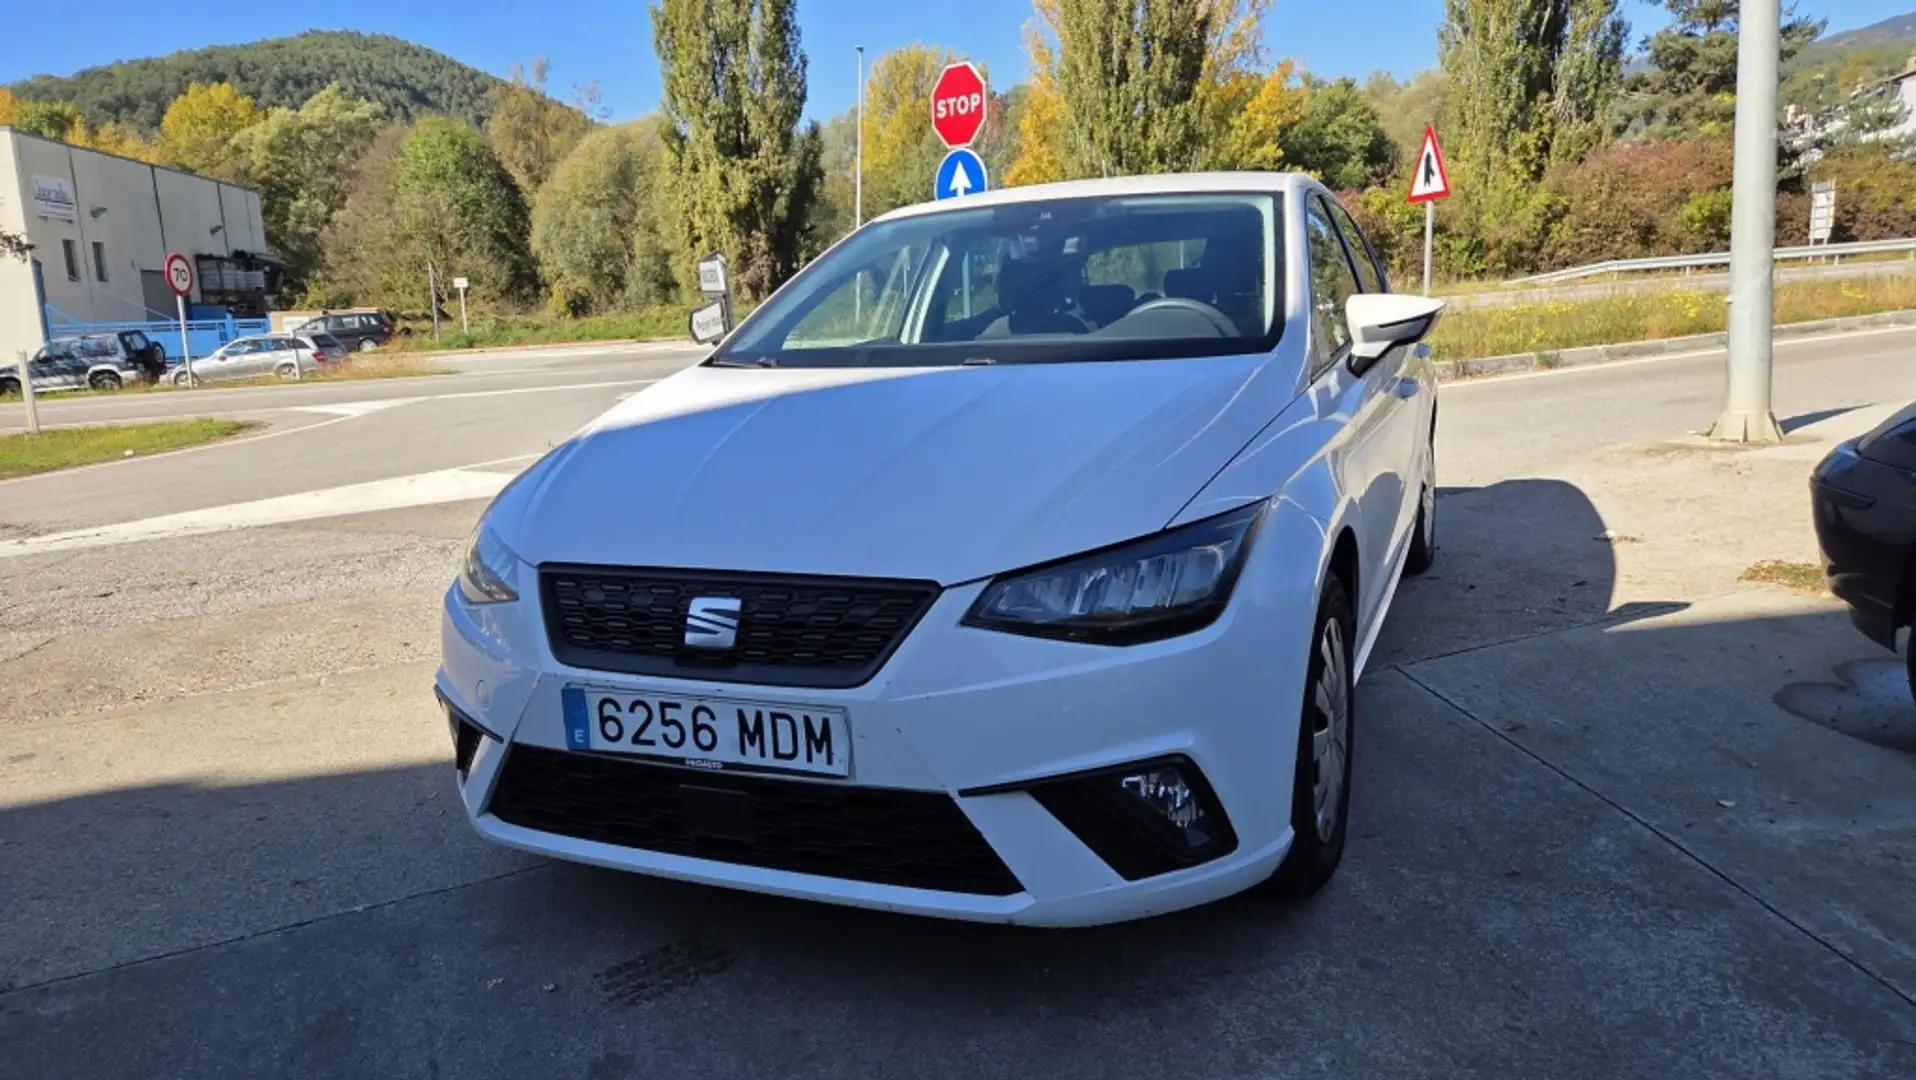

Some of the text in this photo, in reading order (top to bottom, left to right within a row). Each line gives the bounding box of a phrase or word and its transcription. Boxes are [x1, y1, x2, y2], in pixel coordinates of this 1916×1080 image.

[936, 92, 981, 119] STOP
[172, 267, 188, 282] 70
[574, 729, 585, 743] E
[598, 697, 834, 766] 6256 MDM
